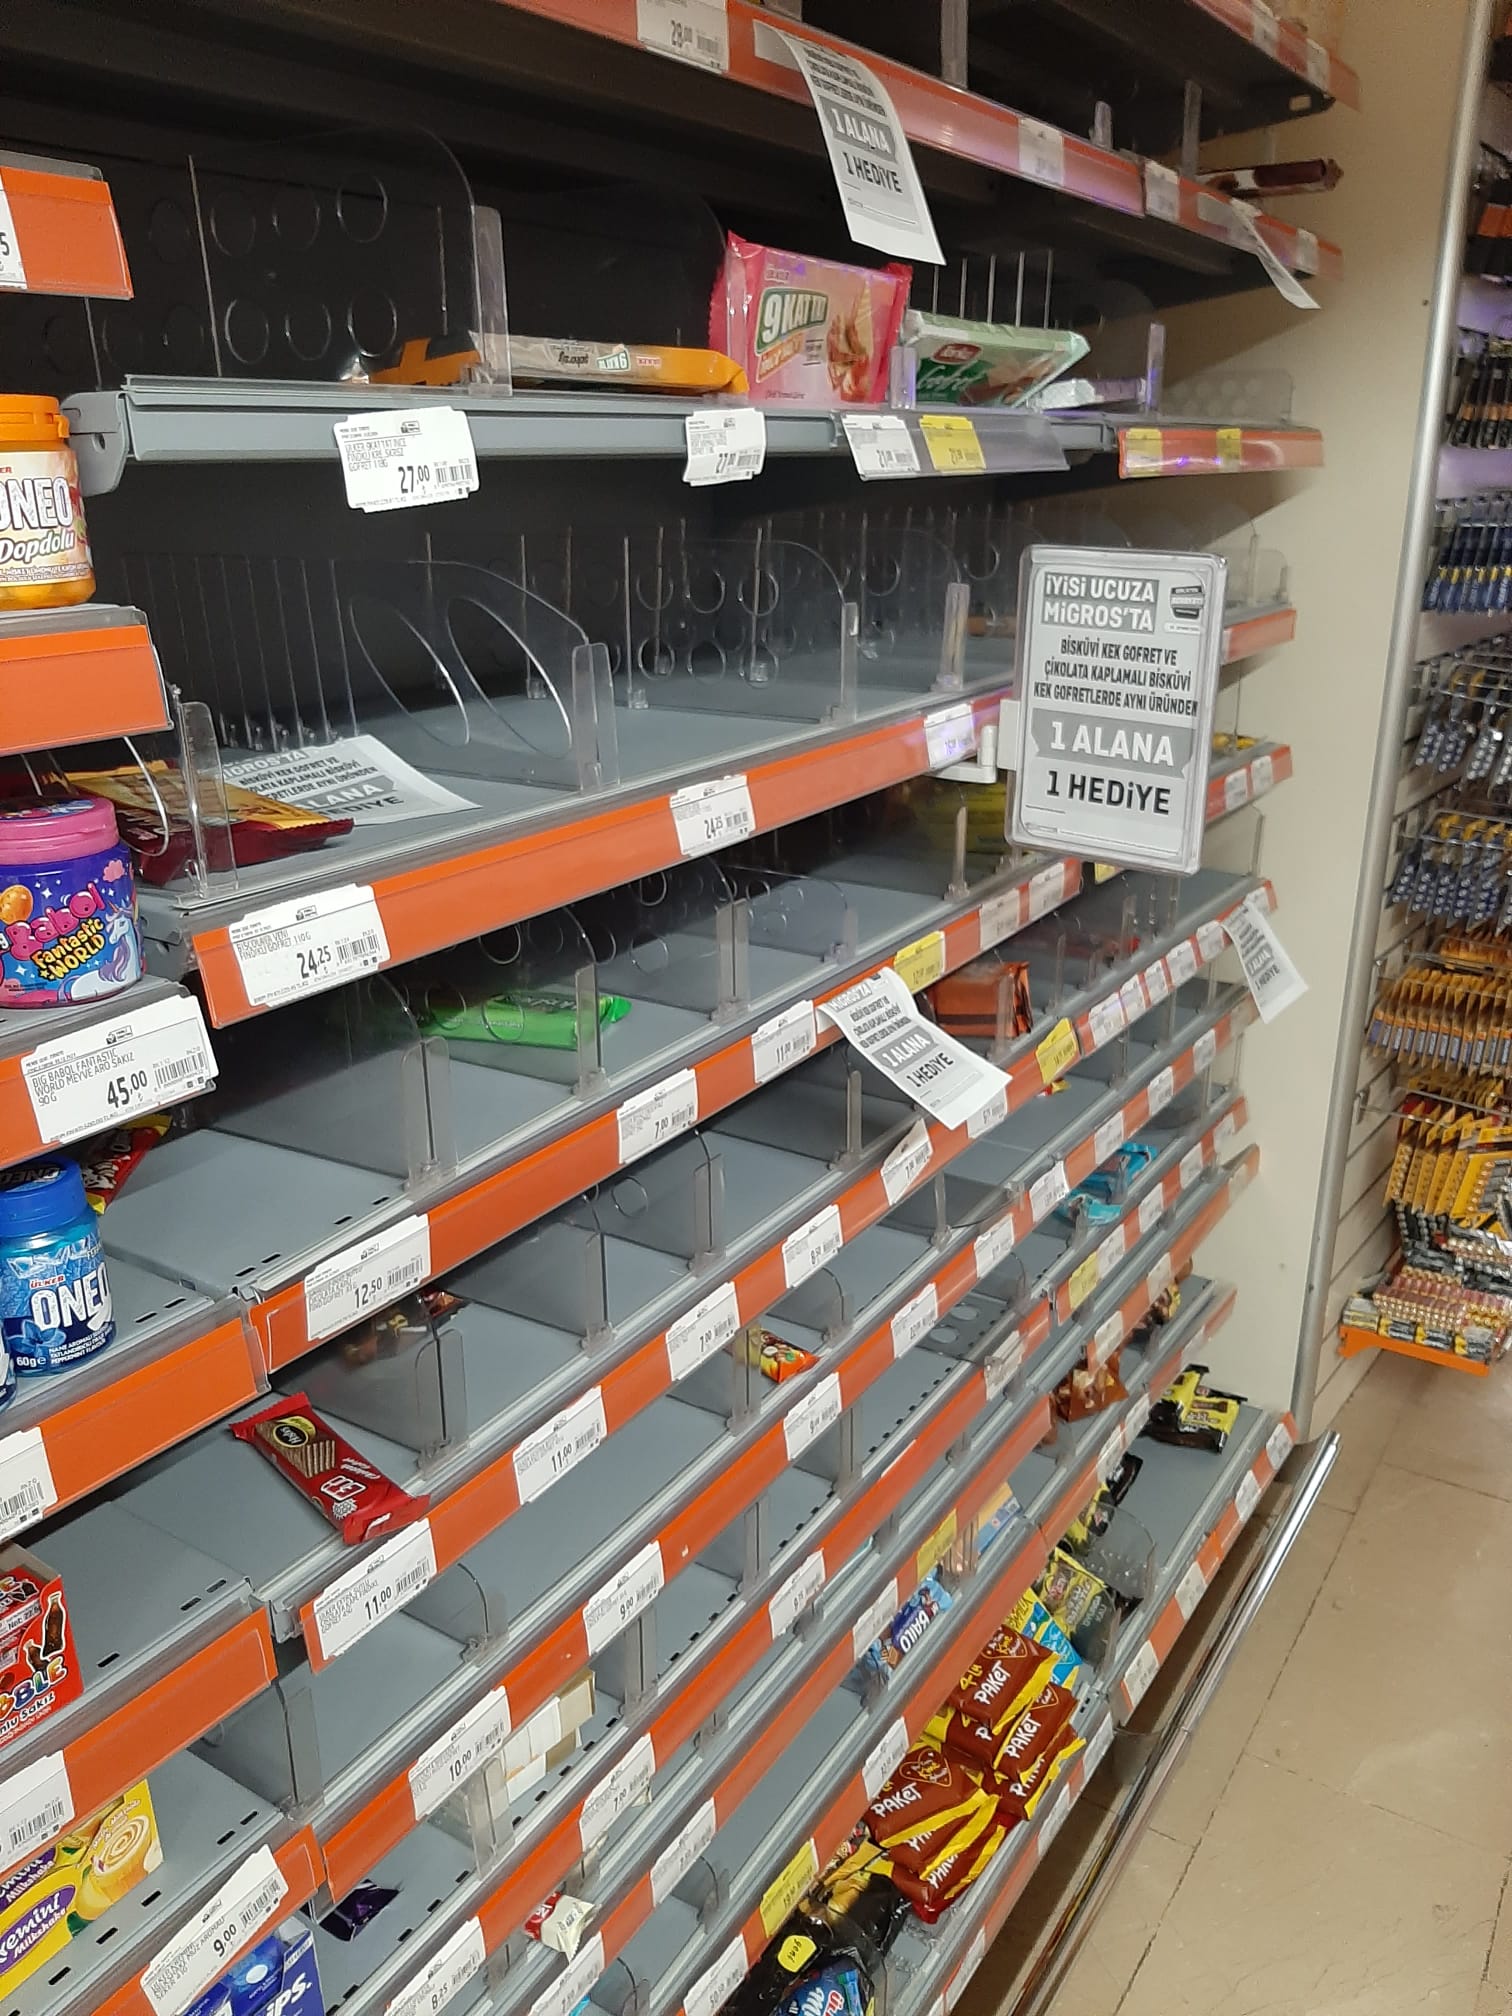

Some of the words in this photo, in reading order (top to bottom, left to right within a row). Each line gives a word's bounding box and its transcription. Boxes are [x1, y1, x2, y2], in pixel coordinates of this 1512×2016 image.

[842, 152, 855, 176] 1
[1090, 577, 1155, 603] UCUZA
[1102, 641, 1121, 660] KEK
[1122, 643, 1162, 664] GOFRET
[1164, 649, 1178, 666] VE
[1091, 663, 1147, 686] KAPLAMALI
[1034, 681, 1052, 698] KEK
[1053, 683, 1122, 707] GOFRETLERDE
[1123, 689, 1148, 709] AYNI
[1050, 720, 1067, 750] 1
[1071, 724, 1175, 767] ALANA
[1046, 770, 1060, 797] 1
[5, 882, 106, 961] Babol
[31, 917, 105, 970] Fantastic
[47, 932, 105, 980] WORLD
[297, 945, 332, 979] 24,25
[891, 1033, 931, 1063] ALANA
[32, 1076, 47, 1088] BIG
[48, 1067, 74, 1082] BABOL
[76, 1048, 118, 1073] FANTASTIC
[34, 1080, 66, 1097] WORLD
[66, 1070, 94, 1087] MEYVE
[93, 1063, 111, 1077] ARO
[906, 1073, 920, 1088] 1
[107, 1070, 148, 1109] 45,00
[30, 1262, 114, 1332] ONEO
[354, 1276, 383, 1309] 12,50
[364, 1586, 392, 1621] 11,00
[449, 1750, 472, 1781] 10,00
[14, 1908, 67, 1960] Milkshake
[213, 1923, 238, 1958] 9,00
